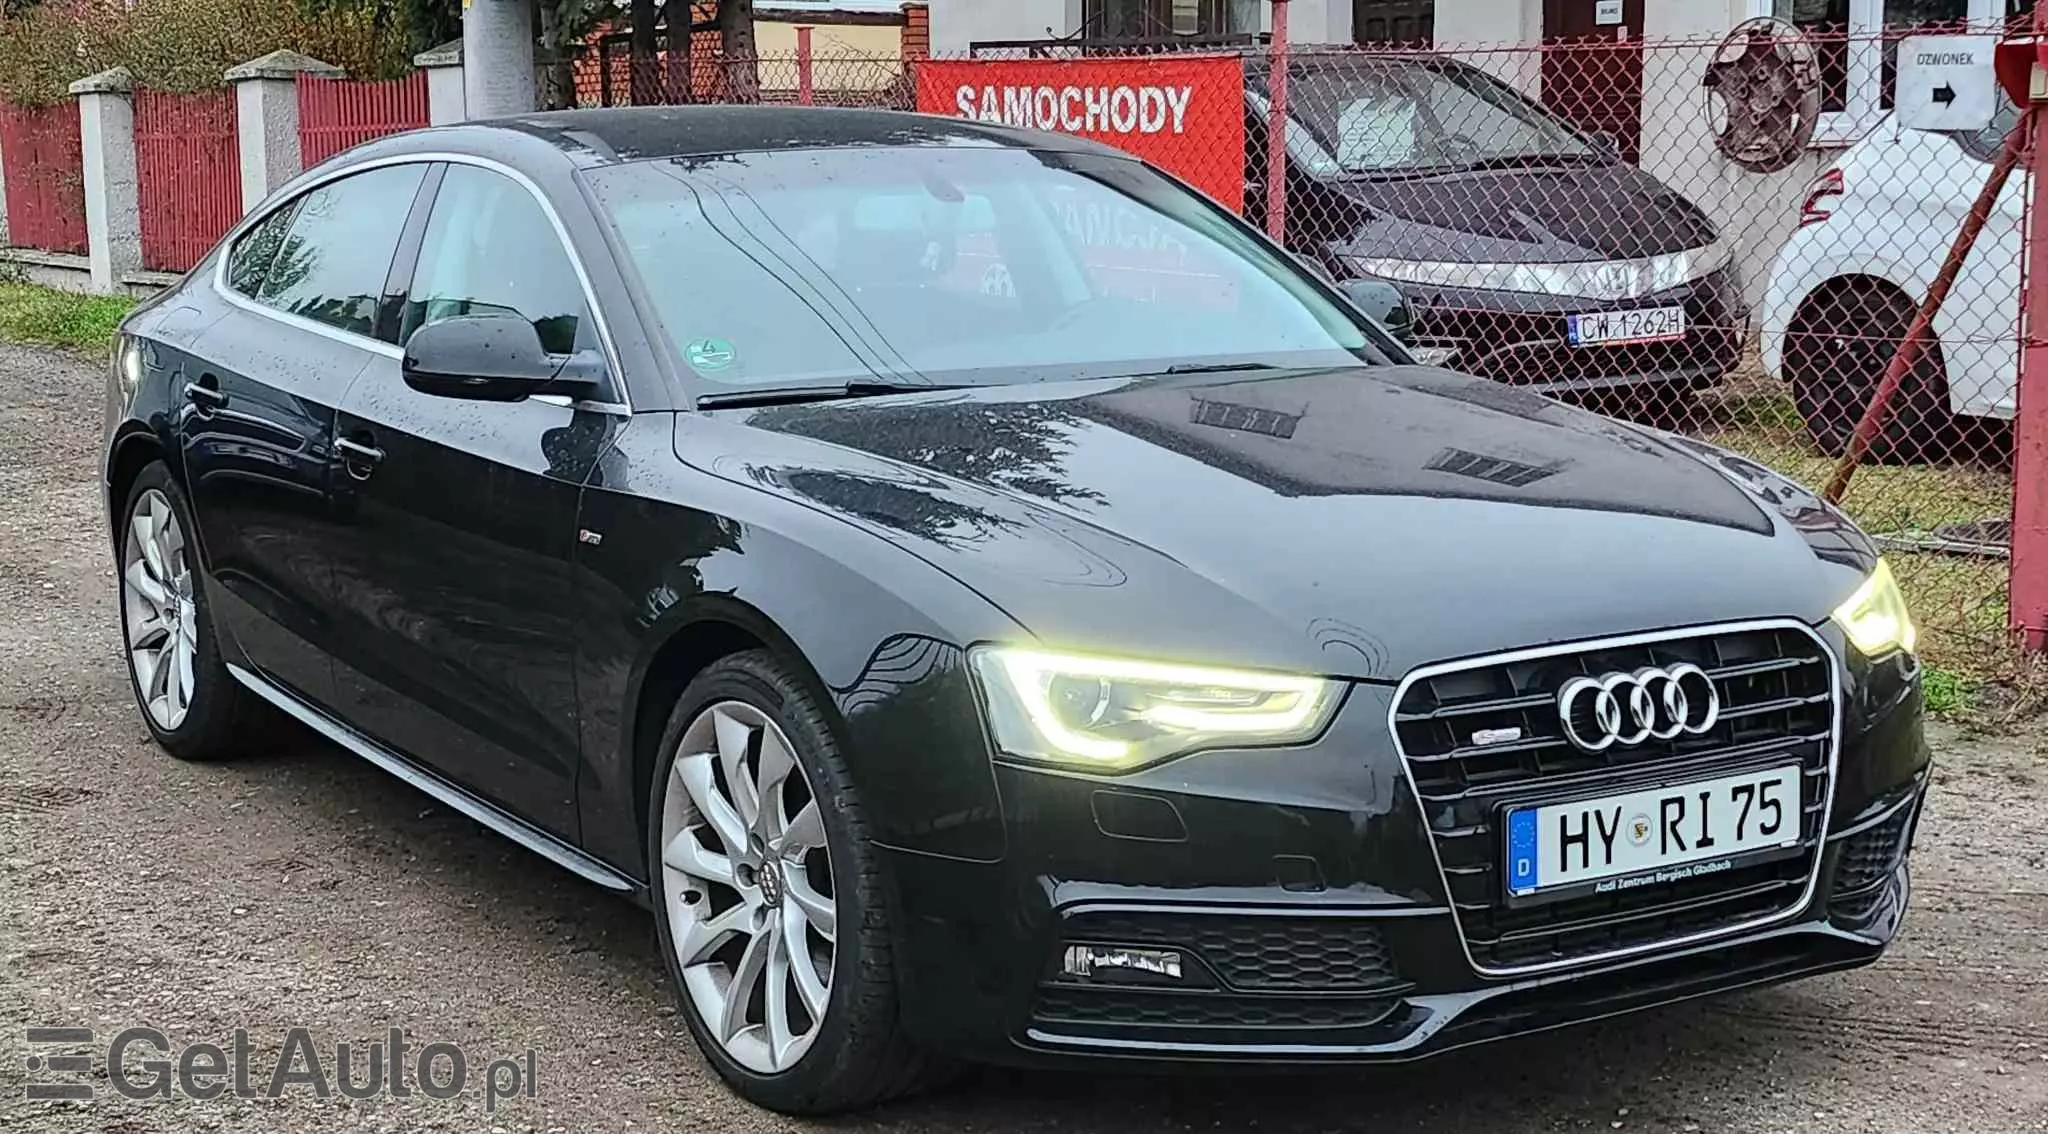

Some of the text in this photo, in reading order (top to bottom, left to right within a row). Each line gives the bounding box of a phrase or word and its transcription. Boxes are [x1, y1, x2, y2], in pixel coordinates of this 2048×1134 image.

[1917, 53, 1975, 66] DZWONEK
[956, 84, 1193, 134] SAMOCHODY
[1582, 313, 1610, 340] CW
[1618, 308, 1680, 337] 1262H
[1560, 779, 1783, 872] HY RI 75
[1517, 858, 1531, 877] D
[1594, 859, 1732, 893] Audi Zentrum Bergisch Gladbach
